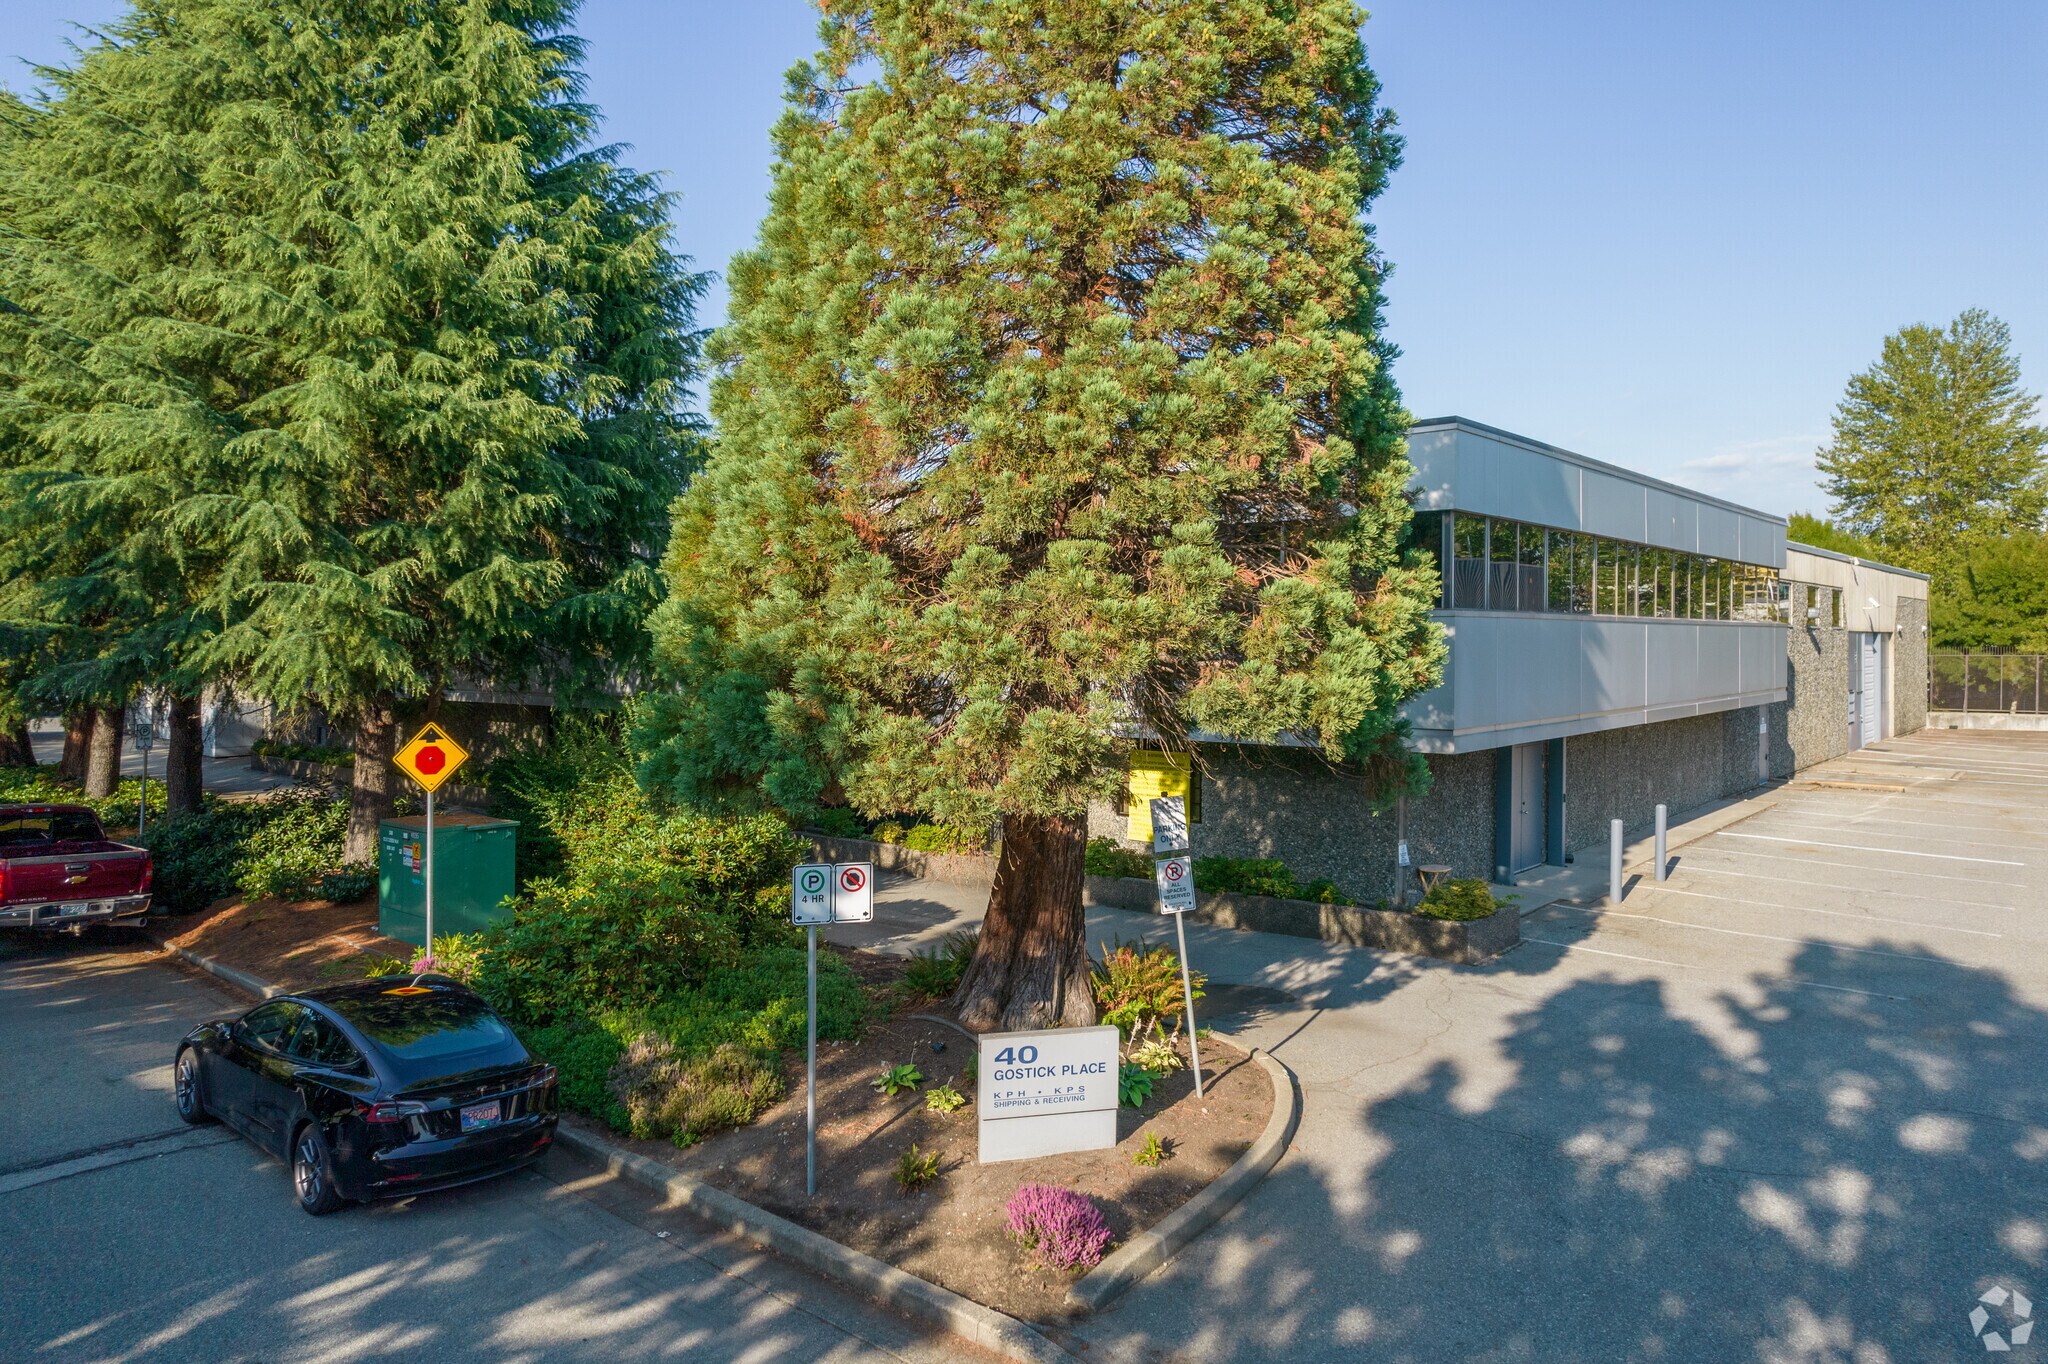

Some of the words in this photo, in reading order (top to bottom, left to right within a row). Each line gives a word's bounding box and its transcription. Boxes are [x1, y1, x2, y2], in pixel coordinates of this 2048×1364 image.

[1153, 823, 1185, 834] PARKING
[1160, 833, 1180, 843] ONLY
[802, 895, 807, 903] 4
[812, 894, 824, 903] HR
[1164, 892, 1190, 900] RESERVED
[994, 1045, 1038, 1065] 40
[994, 1066, 1056, 1081] GOSTICK
[1062, 1062, 1106, 1076] PLACE
[993, 1099, 1031, 1109] SHIPPING
[1043, 1094, 1085, 1104] RECEIVING
